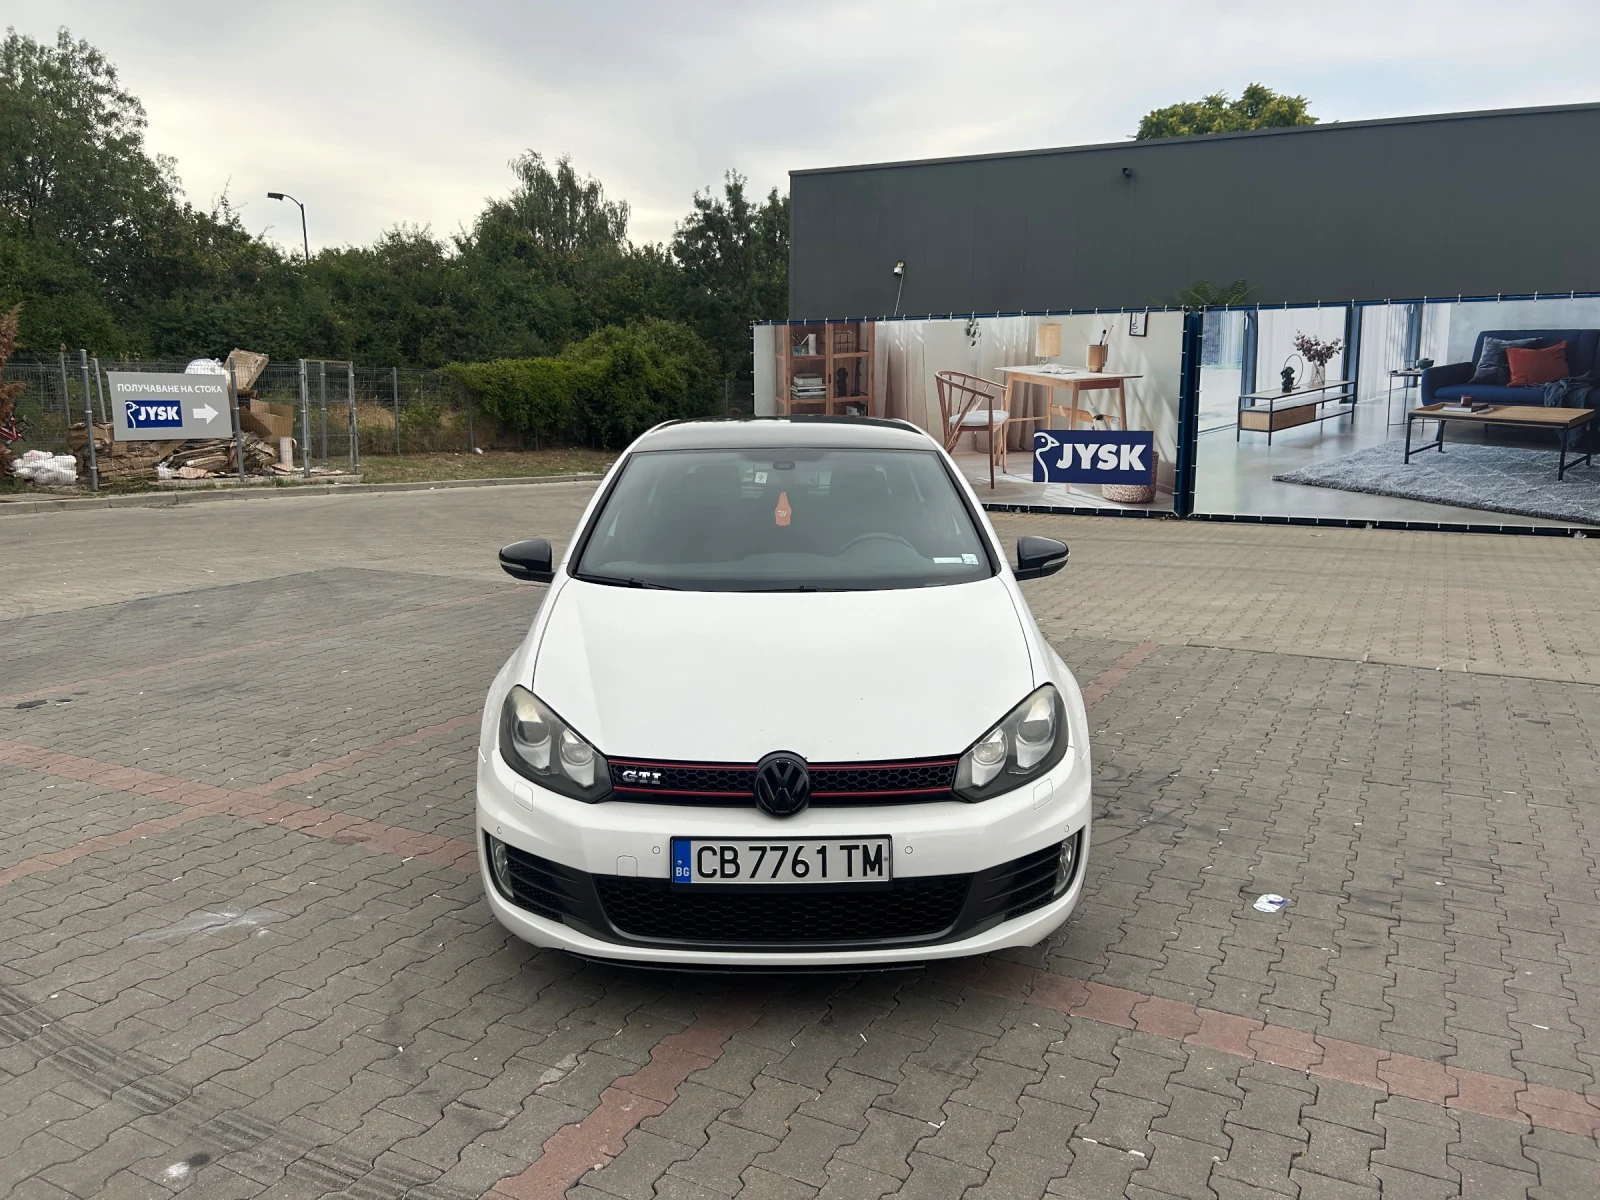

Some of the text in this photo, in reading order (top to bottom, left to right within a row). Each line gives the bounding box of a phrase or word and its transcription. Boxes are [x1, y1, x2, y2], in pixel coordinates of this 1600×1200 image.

[117, 383, 223, 393] ПОЛУЧАВАНЕ НА СТОКА
[138, 406, 180, 421] JYSK
[1056, 443, 1147, 471] JYSK
[622, 770, 662, 785] GTI
[675, 866, 690, 877] BG
